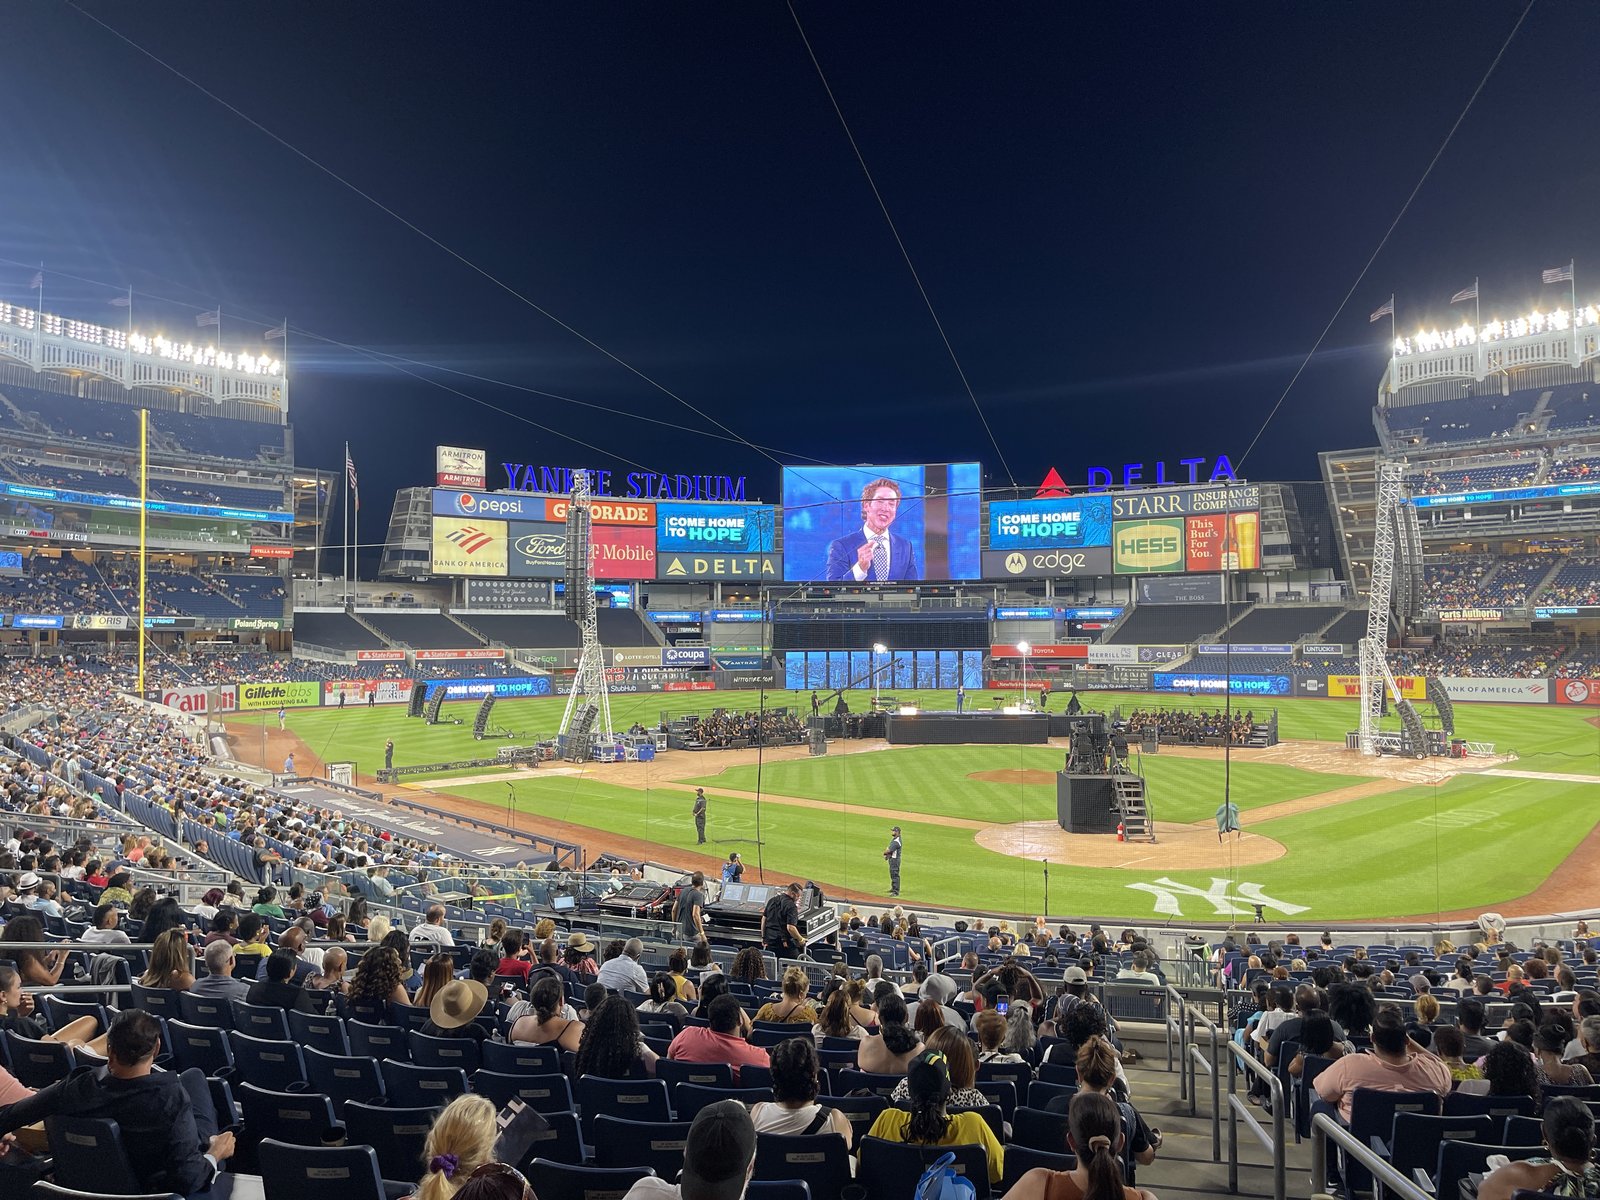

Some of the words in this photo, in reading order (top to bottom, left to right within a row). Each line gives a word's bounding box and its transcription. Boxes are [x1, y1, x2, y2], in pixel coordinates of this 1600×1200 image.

[442, 450, 483, 460] ARMITRON
[444, 474, 480, 482] ARMITRON
[1088, 455, 1237, 493] DELTA
[626, 472, 746, 501] STADIUM
[1194, 488, 1259, 502] INSURANCE
[1114, 495, 1184, 516] STARR
[1194, 497, 1259, 511] COMPANIES
[553, 503, 649, 522] GORADE
[1002, 514, 1040, 524] COME
[1042, 512, 1080, 522] HOME
[669, 517, 706, 527] COME
[708, 518, 745, 528] HOME
[1190, 519, 1213, 529] This
[669, 528, 686, 538] TO
[690, 528, 742, 542] HOPE
[1002, 524, 1019, 535] TO
[1022, 523, 1078, 537] HOPE
[1191, 529, 1218, 538] Bud's
[526, 537, 565, 555] Ford
[1121, 537, 1177, 554] HESS
[1191, 539, 1208, 548] For
[603, 544, 654, 561] Mobile
[1191, 550, 1212, 558] You.
[694, 558, 775, 574] DELTA
[1033, 550, 1085, 574] edge
[1462, 609, 1502, 619] Authority
[234, 620, 256, 628] Poland
[257, 620, 279, 629] Spring
[678, 650, 704, 659] coupa
[447, 686, 468, 694] OME
[1173, 679, 1199, 688] COME
[164, 692, 234, 712] Cann
